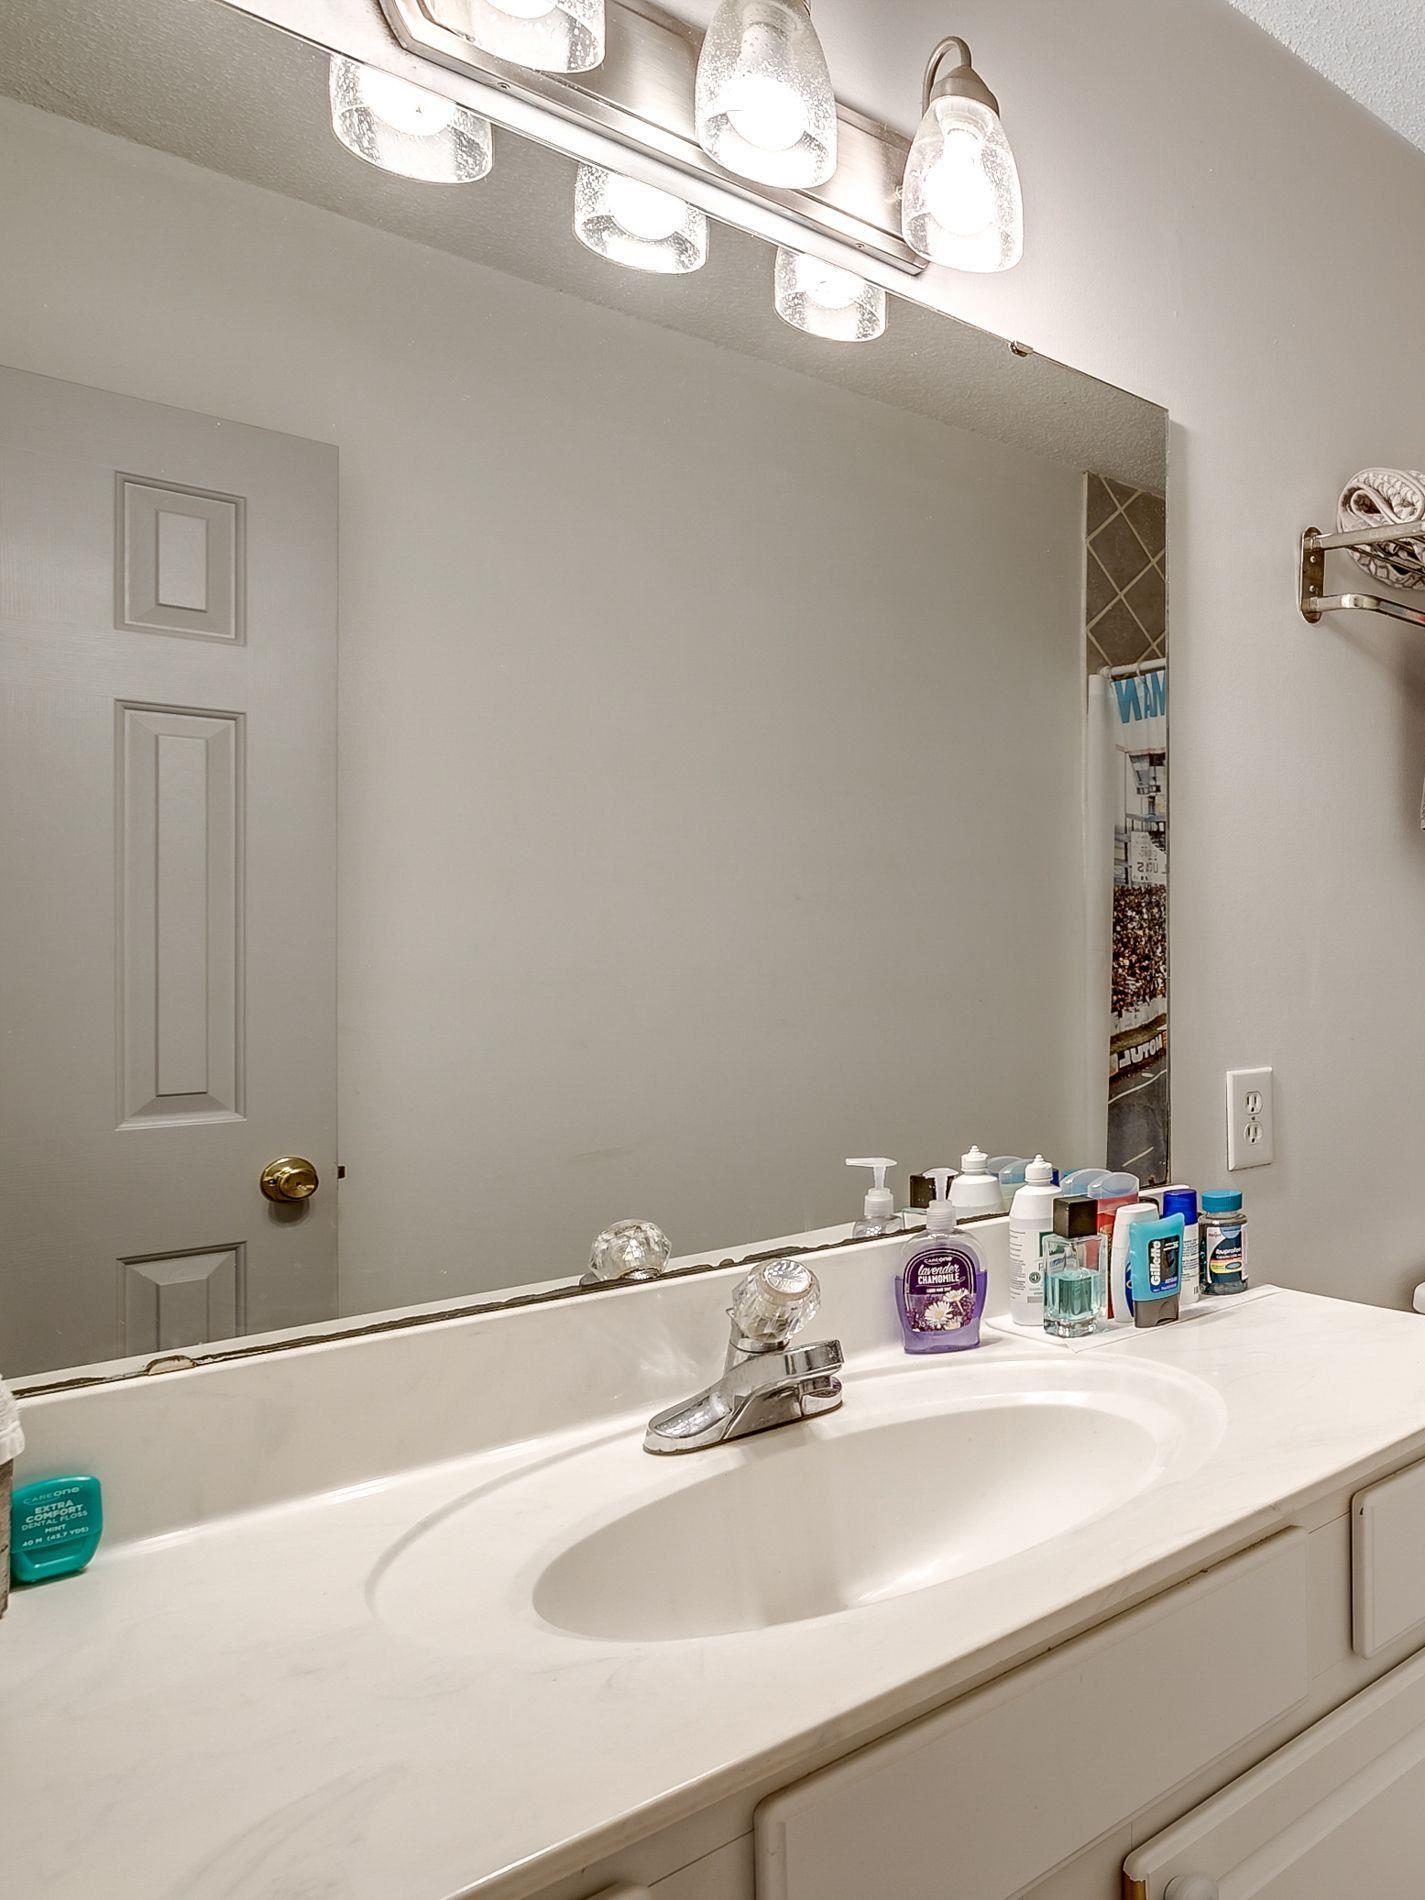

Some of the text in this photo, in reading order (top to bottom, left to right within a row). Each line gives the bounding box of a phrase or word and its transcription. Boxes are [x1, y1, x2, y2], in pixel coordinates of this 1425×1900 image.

[917, 1262, 960, 1275] lavender
[917, 1272, 961, 1285] CHAMOMILE
[25, 1503, 84, 1523] COMFORT
[34, 1499, 74, 1514] EXTRA
[21, 1510, 89, 1531] DENTAL FLOSS
[45, 1523, 67, 1534] MINT
